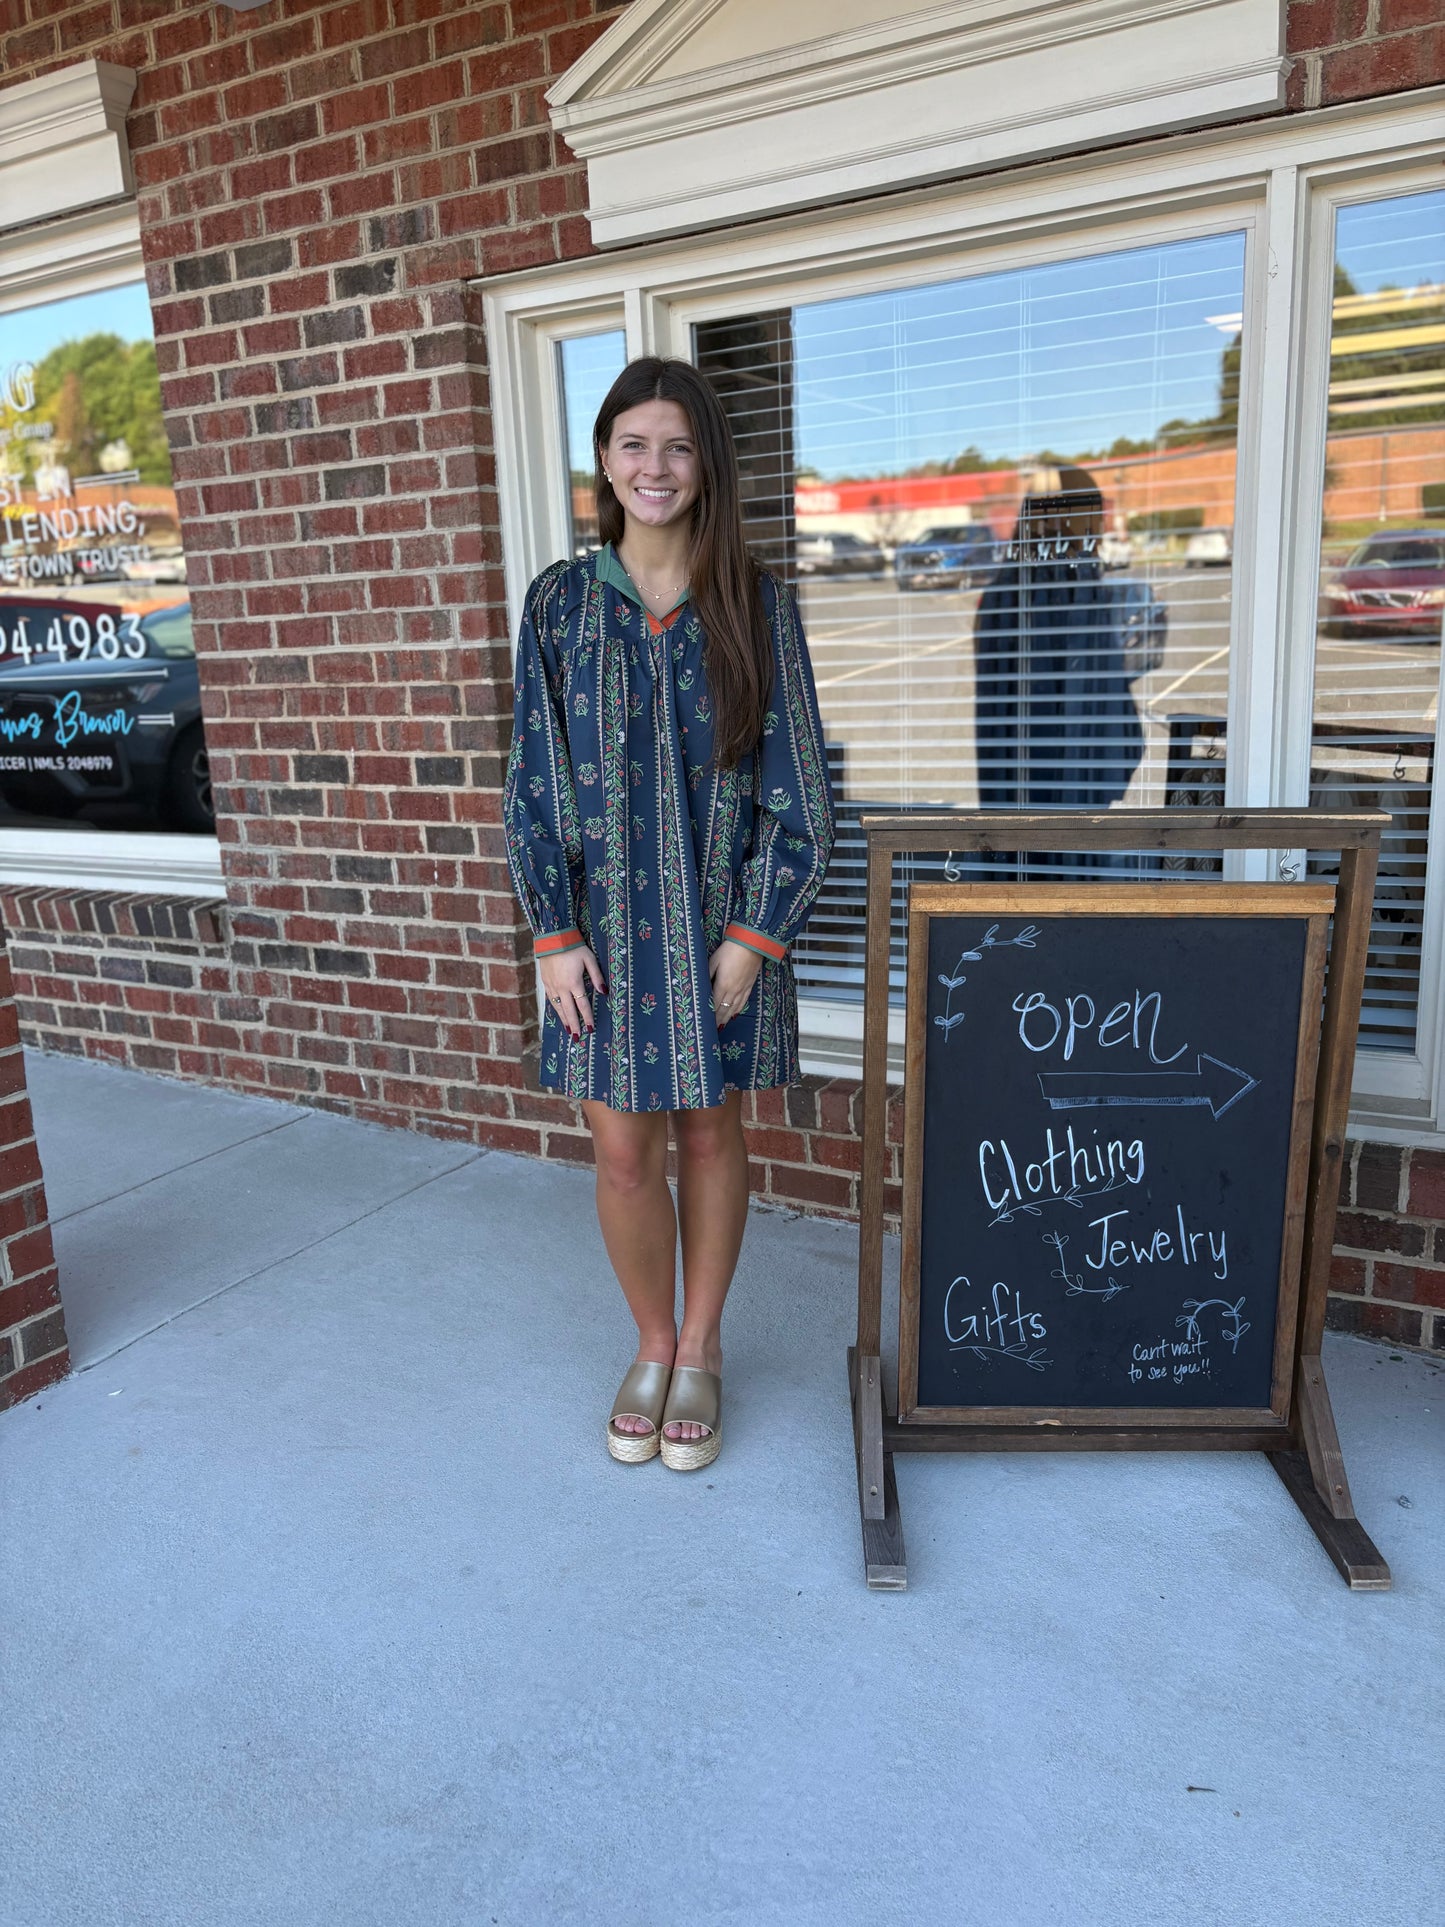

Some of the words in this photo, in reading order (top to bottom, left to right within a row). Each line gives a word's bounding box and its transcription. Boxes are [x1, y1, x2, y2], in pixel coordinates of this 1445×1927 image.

[5, 500, 145, 545] LENDING,
[34, 756, 65, 771] NMLS
[1012, 988, 1188, 1064] Open
[979, 1125, 1145, 1209] Clothing
[1085, 1204, 1228, 1280] Jewelry
[944, 1276, 1047, 1347] Gifts
[1128, 1363, 1142, 1384] to
[1147, 1366, 1168, 1380] see
[1171, 1333, 1209, 1357] wait
